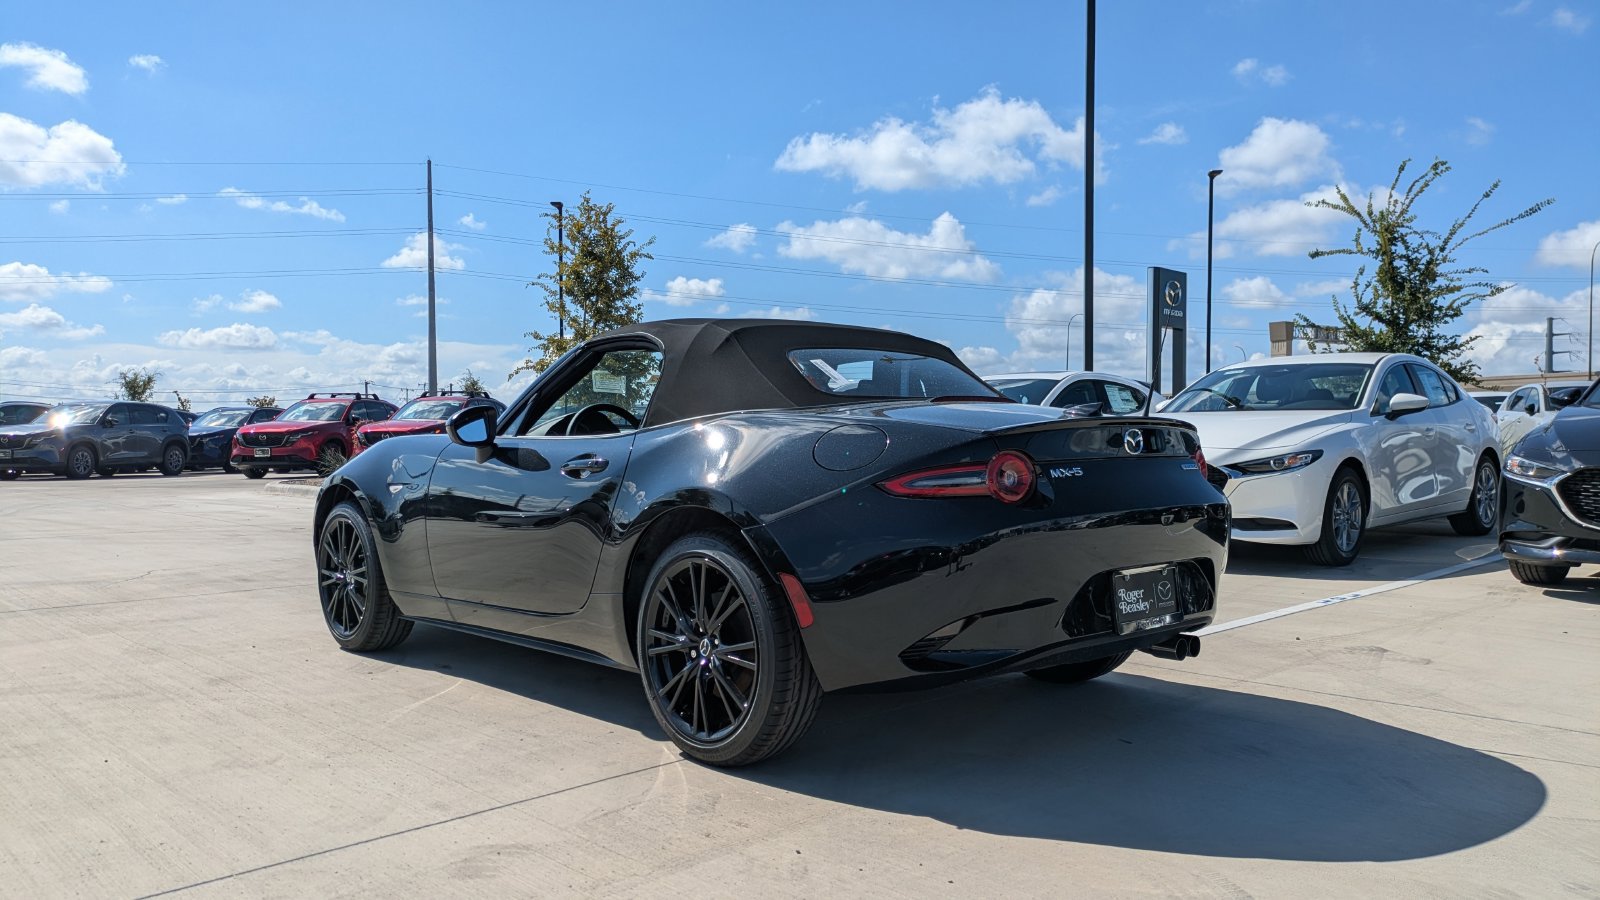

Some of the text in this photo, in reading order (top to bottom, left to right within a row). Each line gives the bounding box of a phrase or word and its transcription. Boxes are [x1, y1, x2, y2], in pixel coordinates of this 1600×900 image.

[1050, 467, 1083, 478] MX-5
[1117, 588, 1144, 603] Roger
[1118, 599, 1153, 614] Beasley
